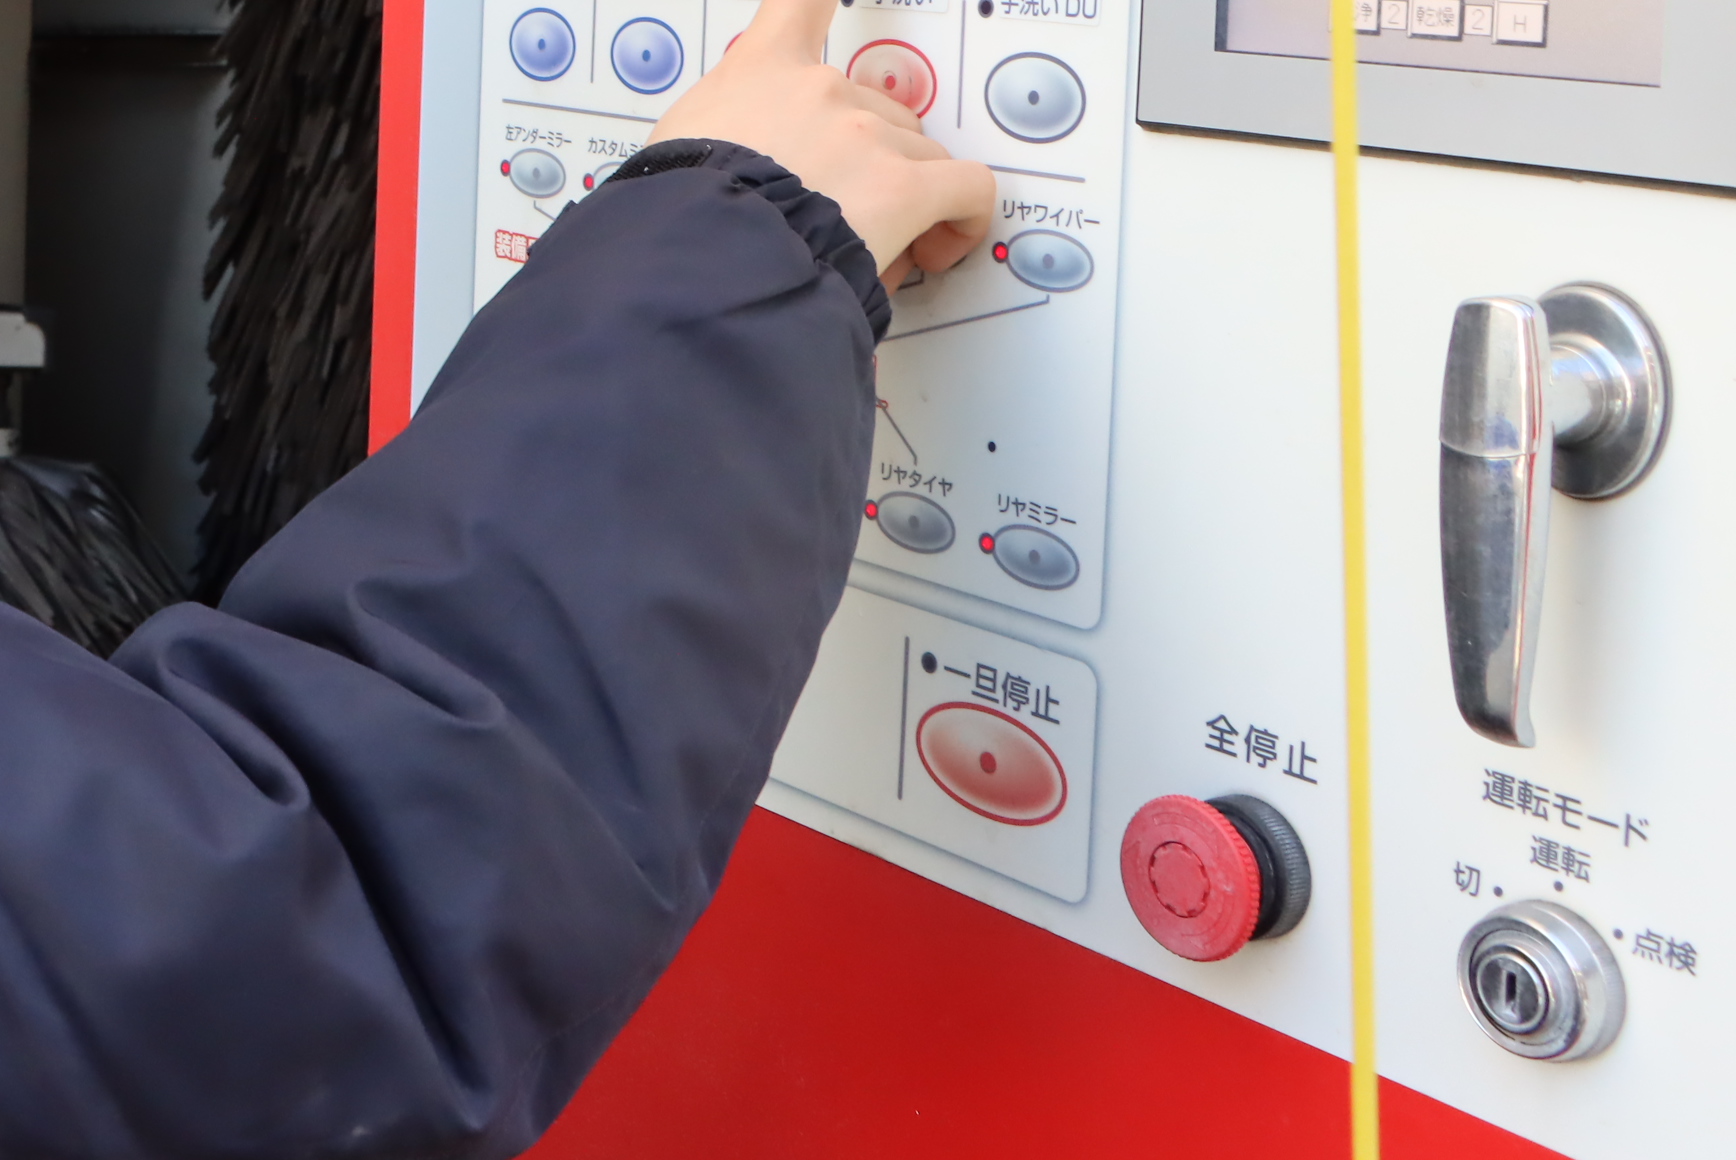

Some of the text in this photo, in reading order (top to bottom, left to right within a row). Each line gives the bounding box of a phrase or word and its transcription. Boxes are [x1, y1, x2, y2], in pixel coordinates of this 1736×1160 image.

[1388, 3, 1400, 25] 2
[1416, 5, 1455, 28] 乾燥
[1472, 8, 1484, 31] 2
[1513, 15, 1527, 34] H
[505, 124, 573, 148] 左アンダーミラー
[588, 137, 646, 159] カスタムミ
[1003, 199, 1101, 230] リヤワイパー
[495, 229, 540, 264] 装備
[881, 462, 954, 497] リヤタイヤ
[998, 493, 1077, 525] リヤミラー
[943, 662, 1061, 725] 一旦停止
[1205, 713, 1319, 785] 全停止
[1482, 768, 1650, 848] 運転モード
[1530, 834, 1592, 884] 運転
[1453, 860, 1482, 897] 切
[1632, 928, 1698, 976] 点検
